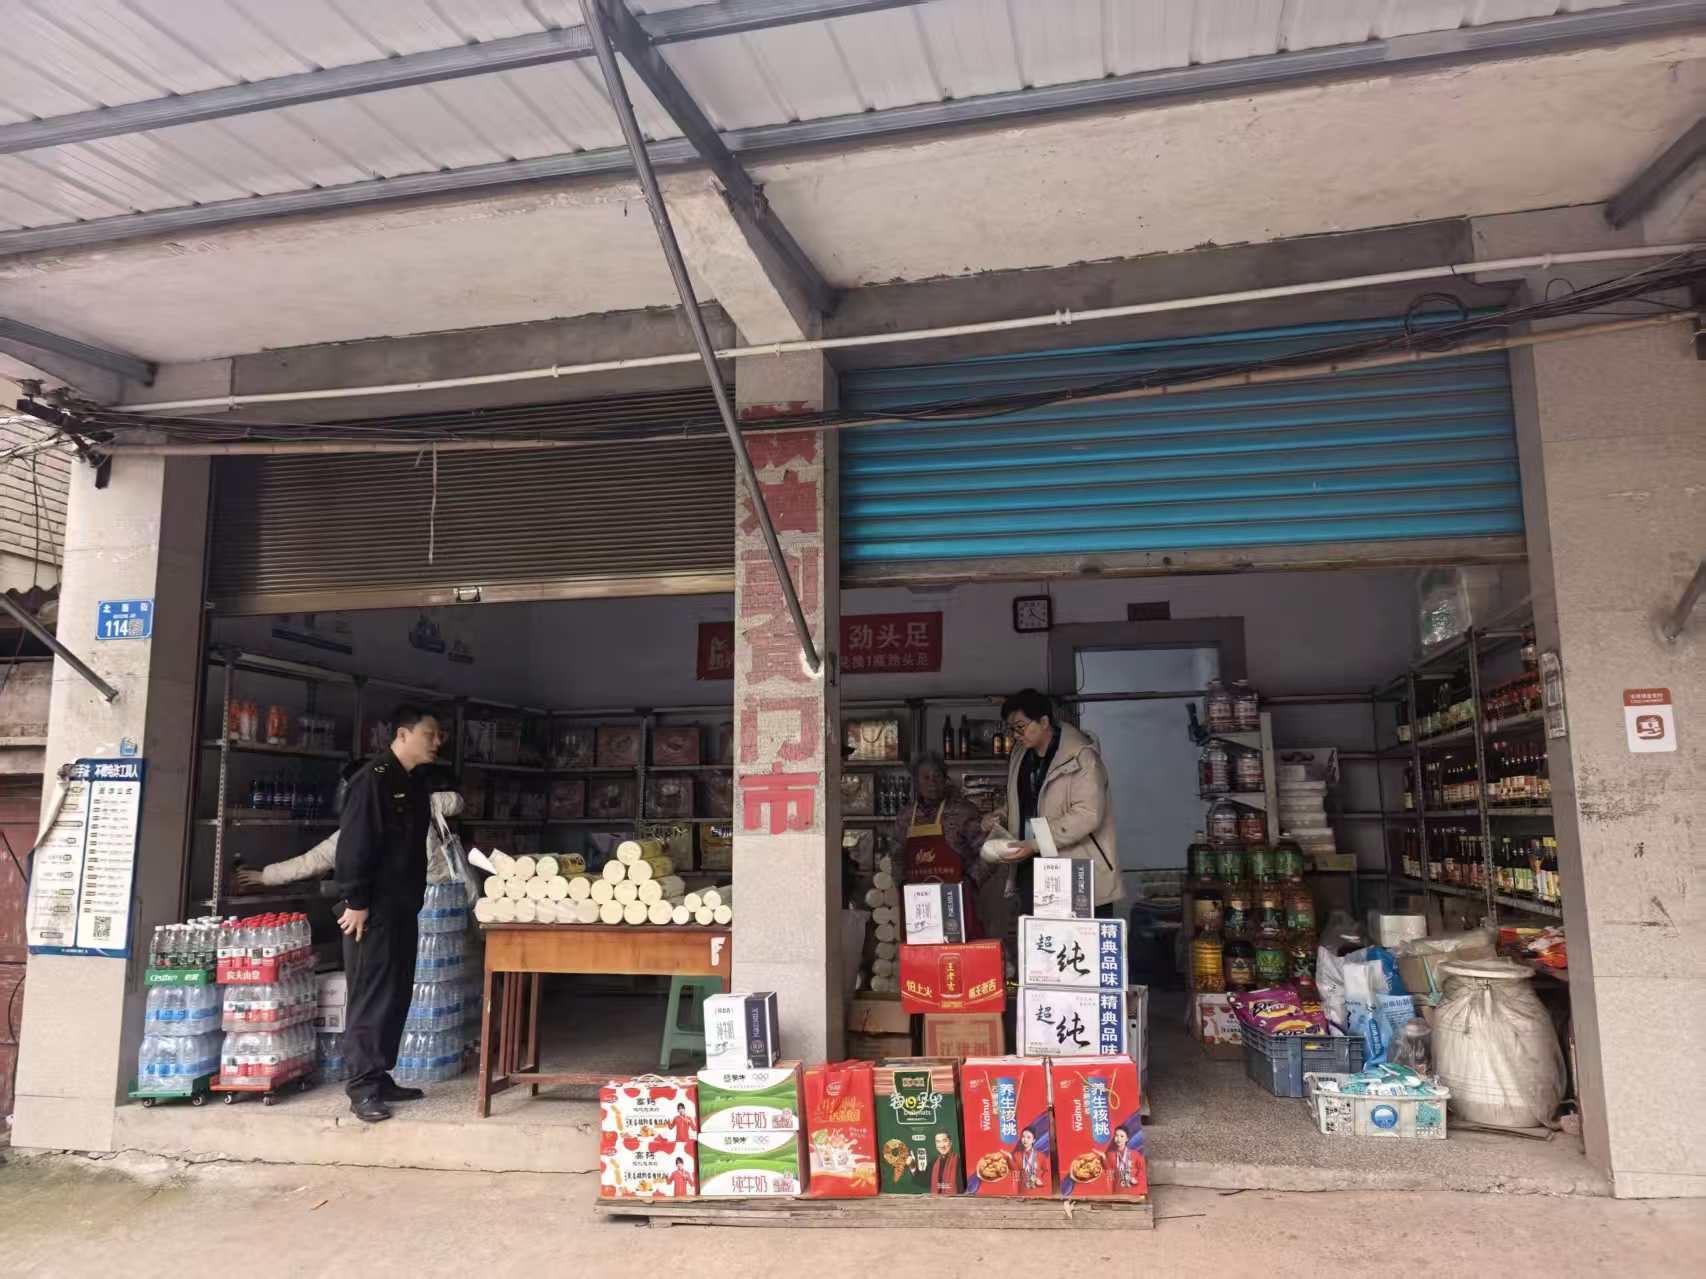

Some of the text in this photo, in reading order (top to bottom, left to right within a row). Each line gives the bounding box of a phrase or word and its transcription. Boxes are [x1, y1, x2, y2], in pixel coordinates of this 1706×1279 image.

[105, 619, 128, 637] 114
[848, 621, 929, 651] 劲头足
[1100, 923, 1119, 986] 精典品味
[731, 1112, 767, 1129] 纯牛奶
[1000, 1083, 1017, 1136] 养生核桃
[1091, 1083, 1110, 1136] 养生核桃
[731, 1176, 768, 1193] 纯牛奶
